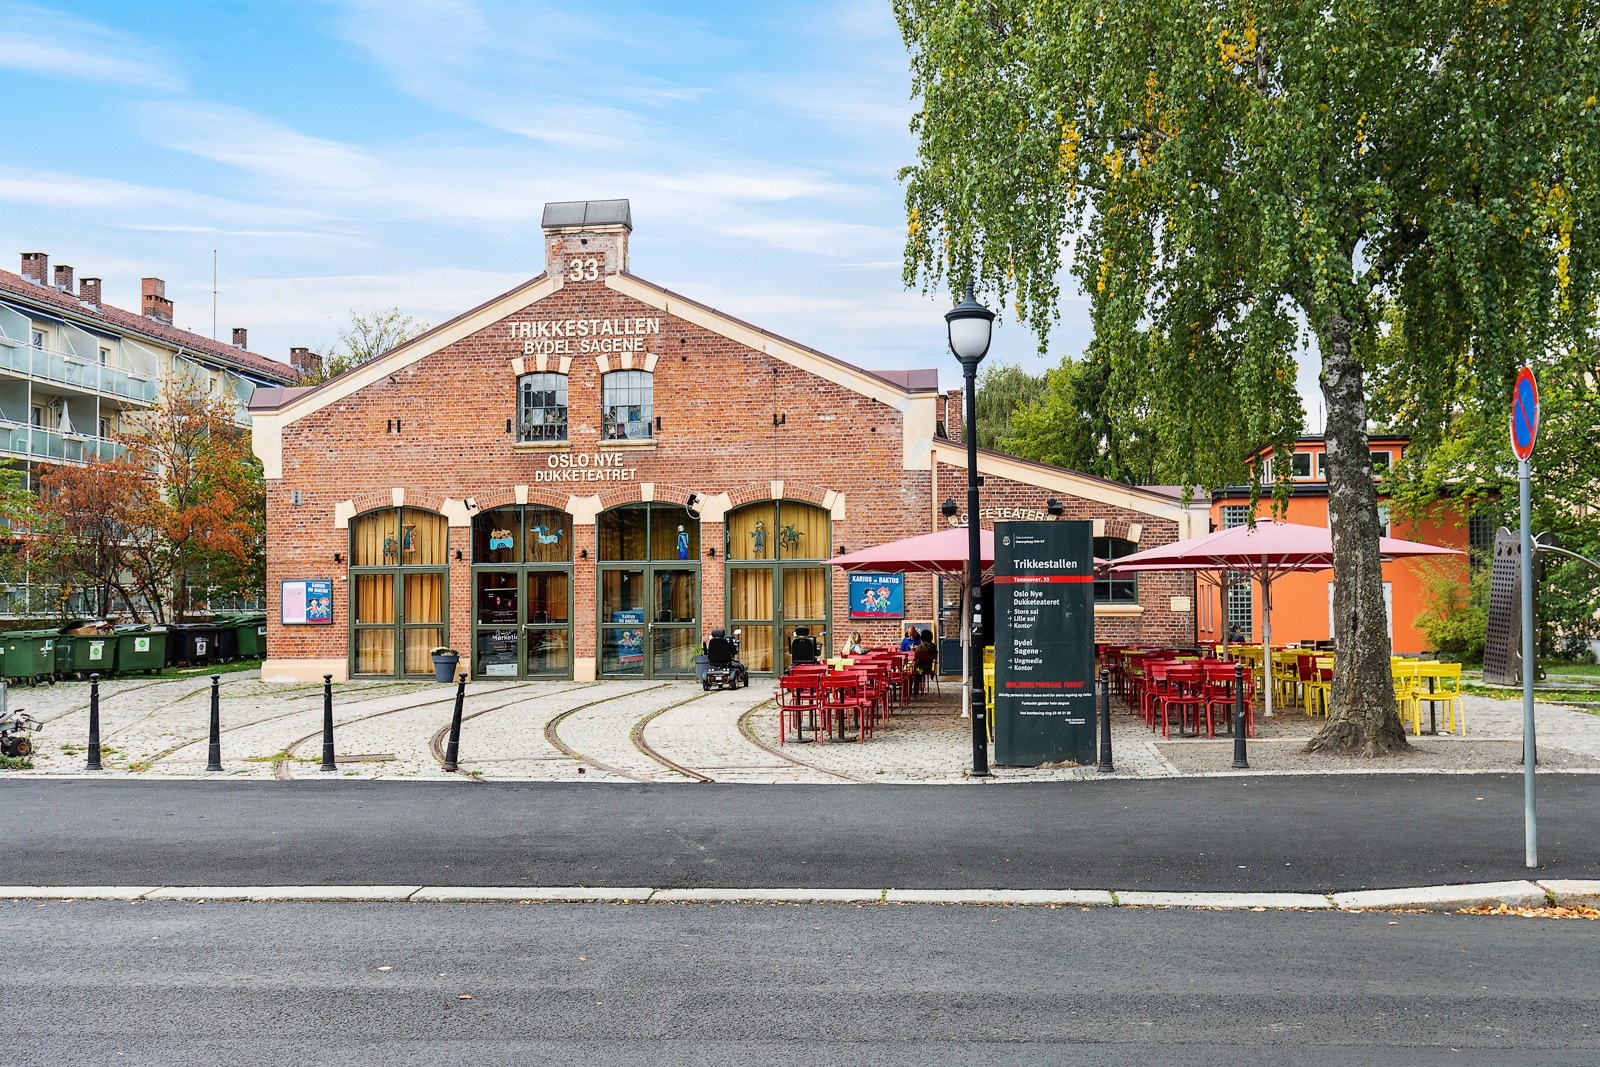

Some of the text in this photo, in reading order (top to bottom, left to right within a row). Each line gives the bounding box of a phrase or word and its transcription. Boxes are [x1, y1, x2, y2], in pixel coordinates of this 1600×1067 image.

[570, 258, 599, 282] 33
[508, 318, 660, 338] TRIKKESTALLEN
[524, 338, 644, 354] BYDEL SAGENE
[547, 453, 624, 468] OSLO NYE
[535, 468, 636, 482] DUKKETEATRET
[1014, 559, 1078, 568] Trikkestallen
[1014, 639, 1032, 647] Bydel
